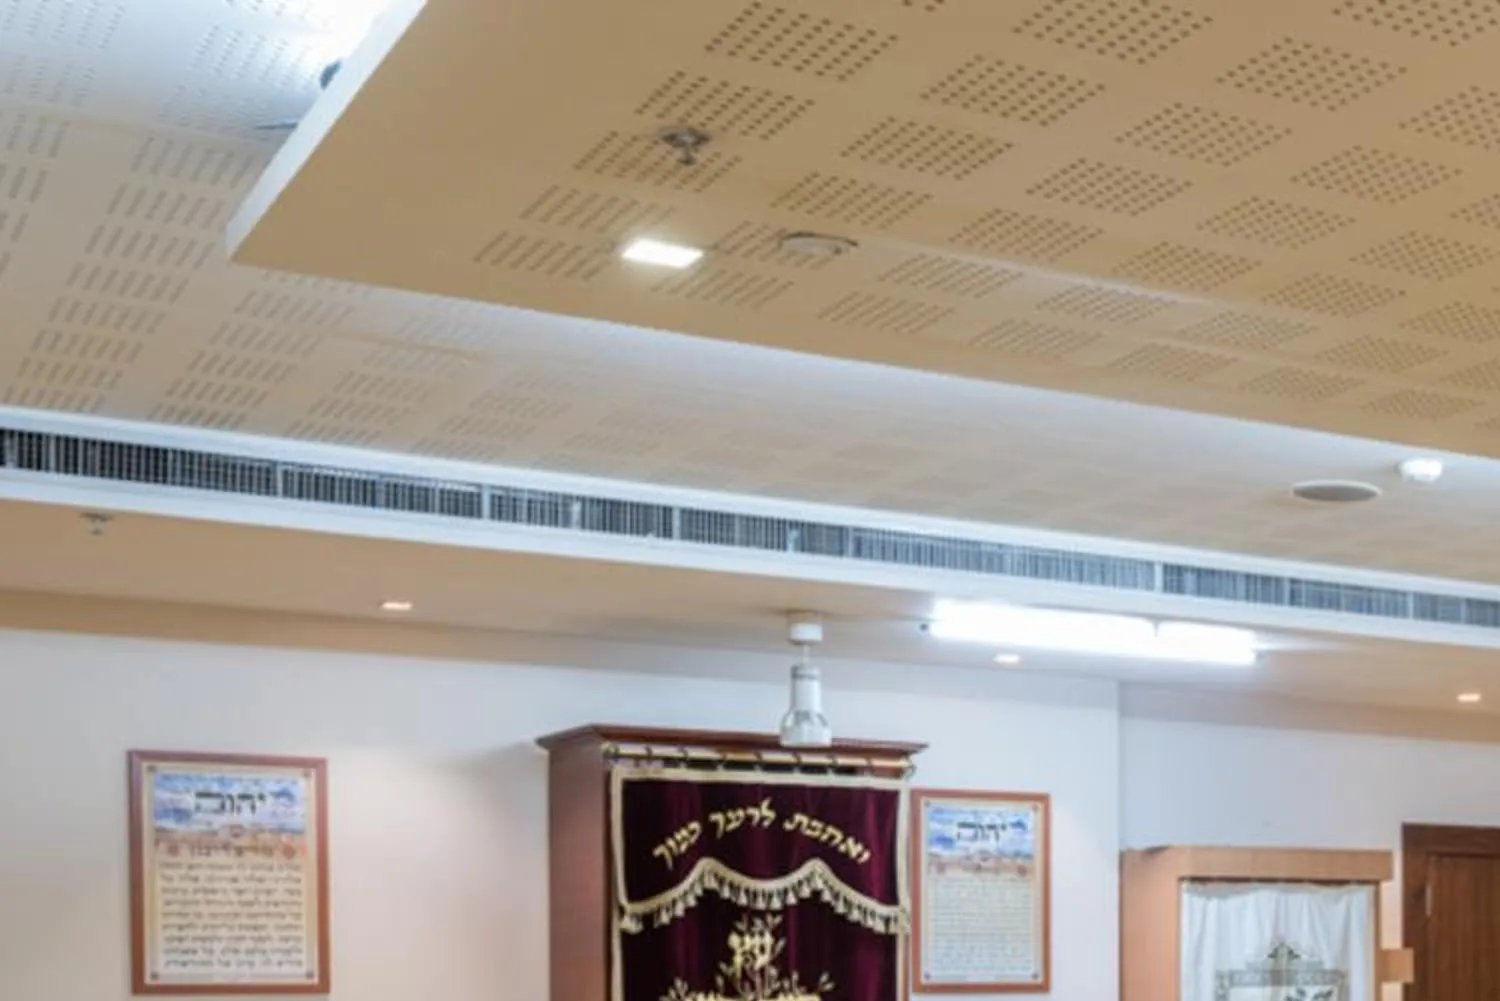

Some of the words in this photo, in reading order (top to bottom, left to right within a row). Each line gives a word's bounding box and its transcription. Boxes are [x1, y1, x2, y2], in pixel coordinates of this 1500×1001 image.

[708, 797, 777, 838] לרעך
[783, 811, 872, 864] ואהבת
[652, 820, 703, 870] כמוך
